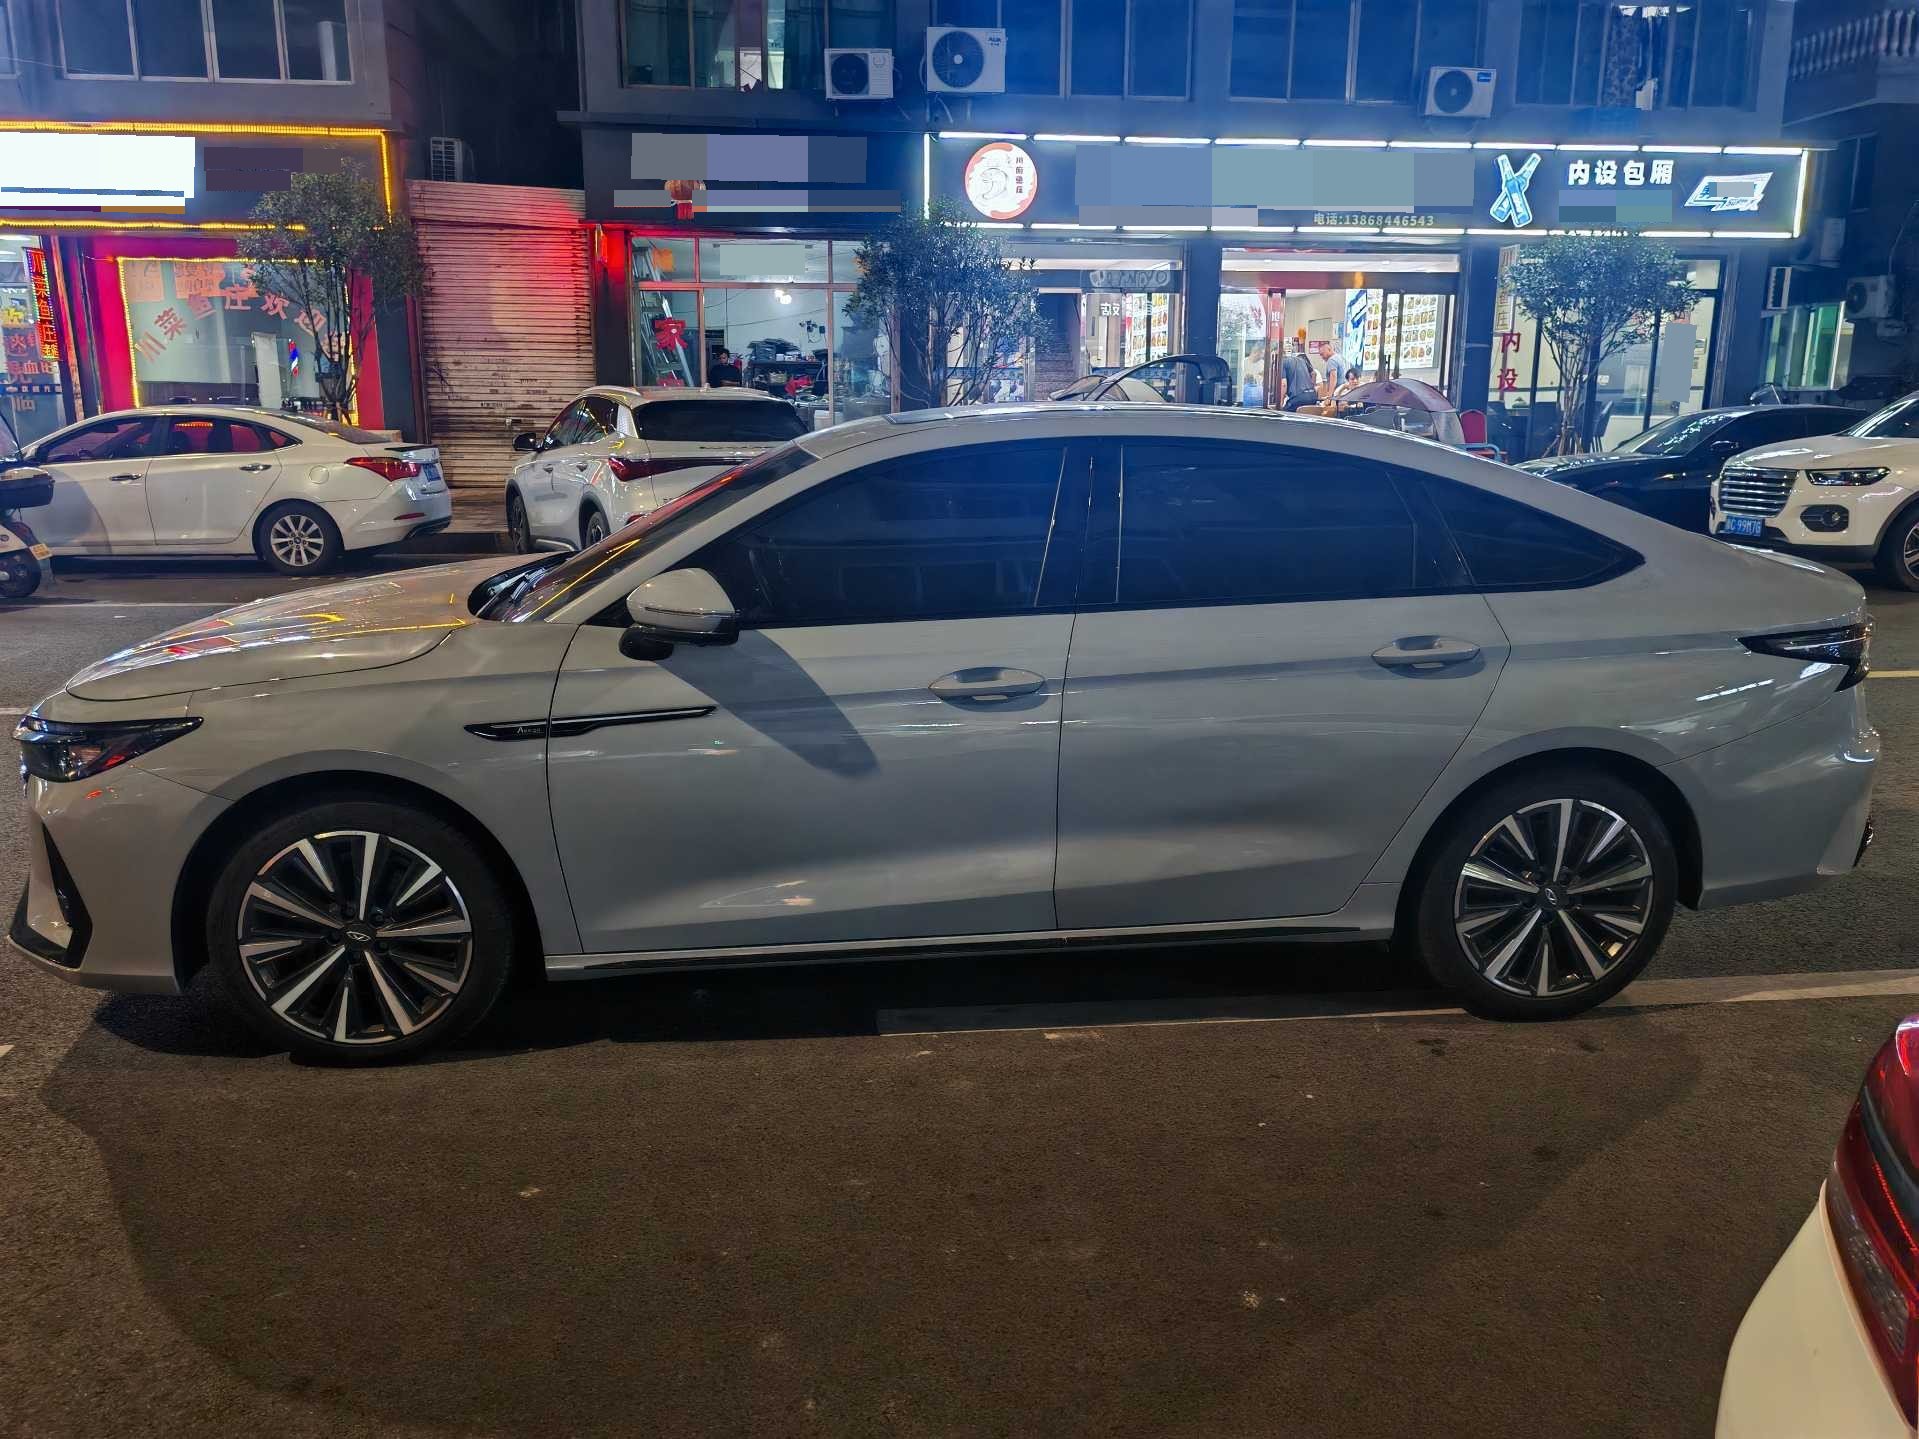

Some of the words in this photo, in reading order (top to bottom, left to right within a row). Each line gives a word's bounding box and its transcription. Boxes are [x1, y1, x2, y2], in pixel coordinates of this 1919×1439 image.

[1568, 160, 1674, 185] 内设包厢
[1497, 332, 1521, 390] 内设
